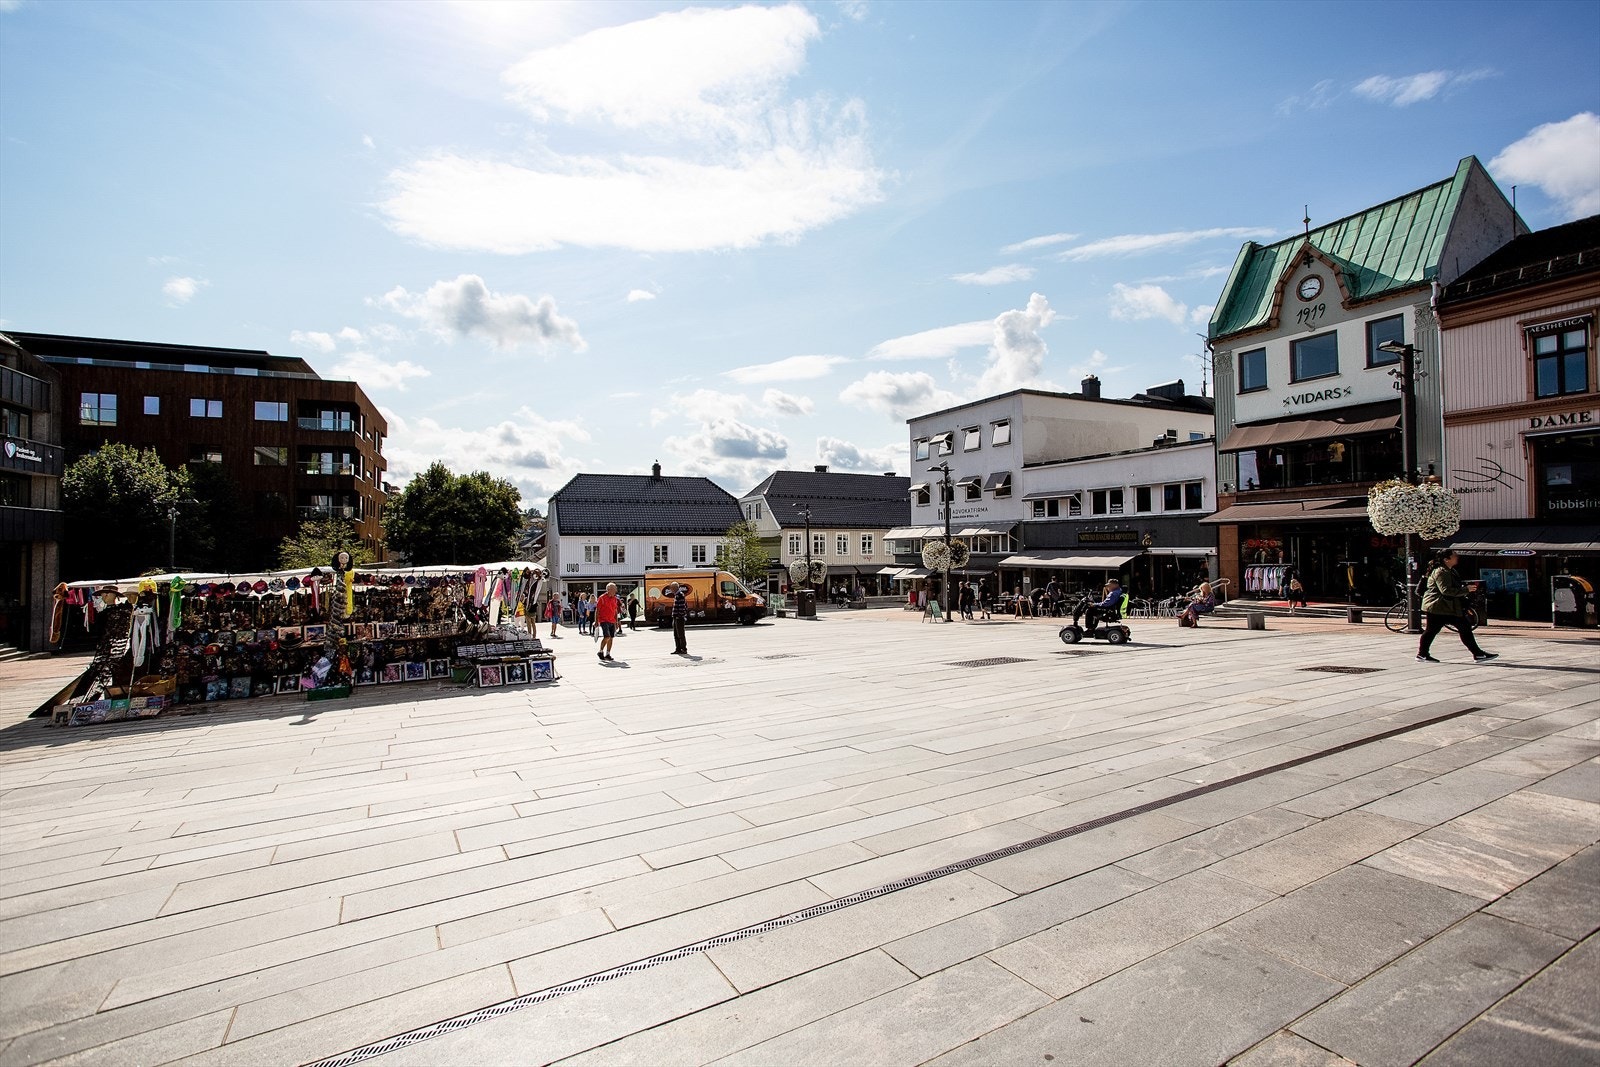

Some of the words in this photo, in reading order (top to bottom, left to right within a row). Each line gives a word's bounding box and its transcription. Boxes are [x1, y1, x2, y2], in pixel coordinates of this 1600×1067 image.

[1296, 303, 1326, 324] 1919
[1529, 318, 1585, 333] AESTHETICA
[1291, 387, 1342, 405] VIDARS
[1530, 411, 1592, 428] DAME
[952, 507, 989, 515] ADVOKATFIRMA
